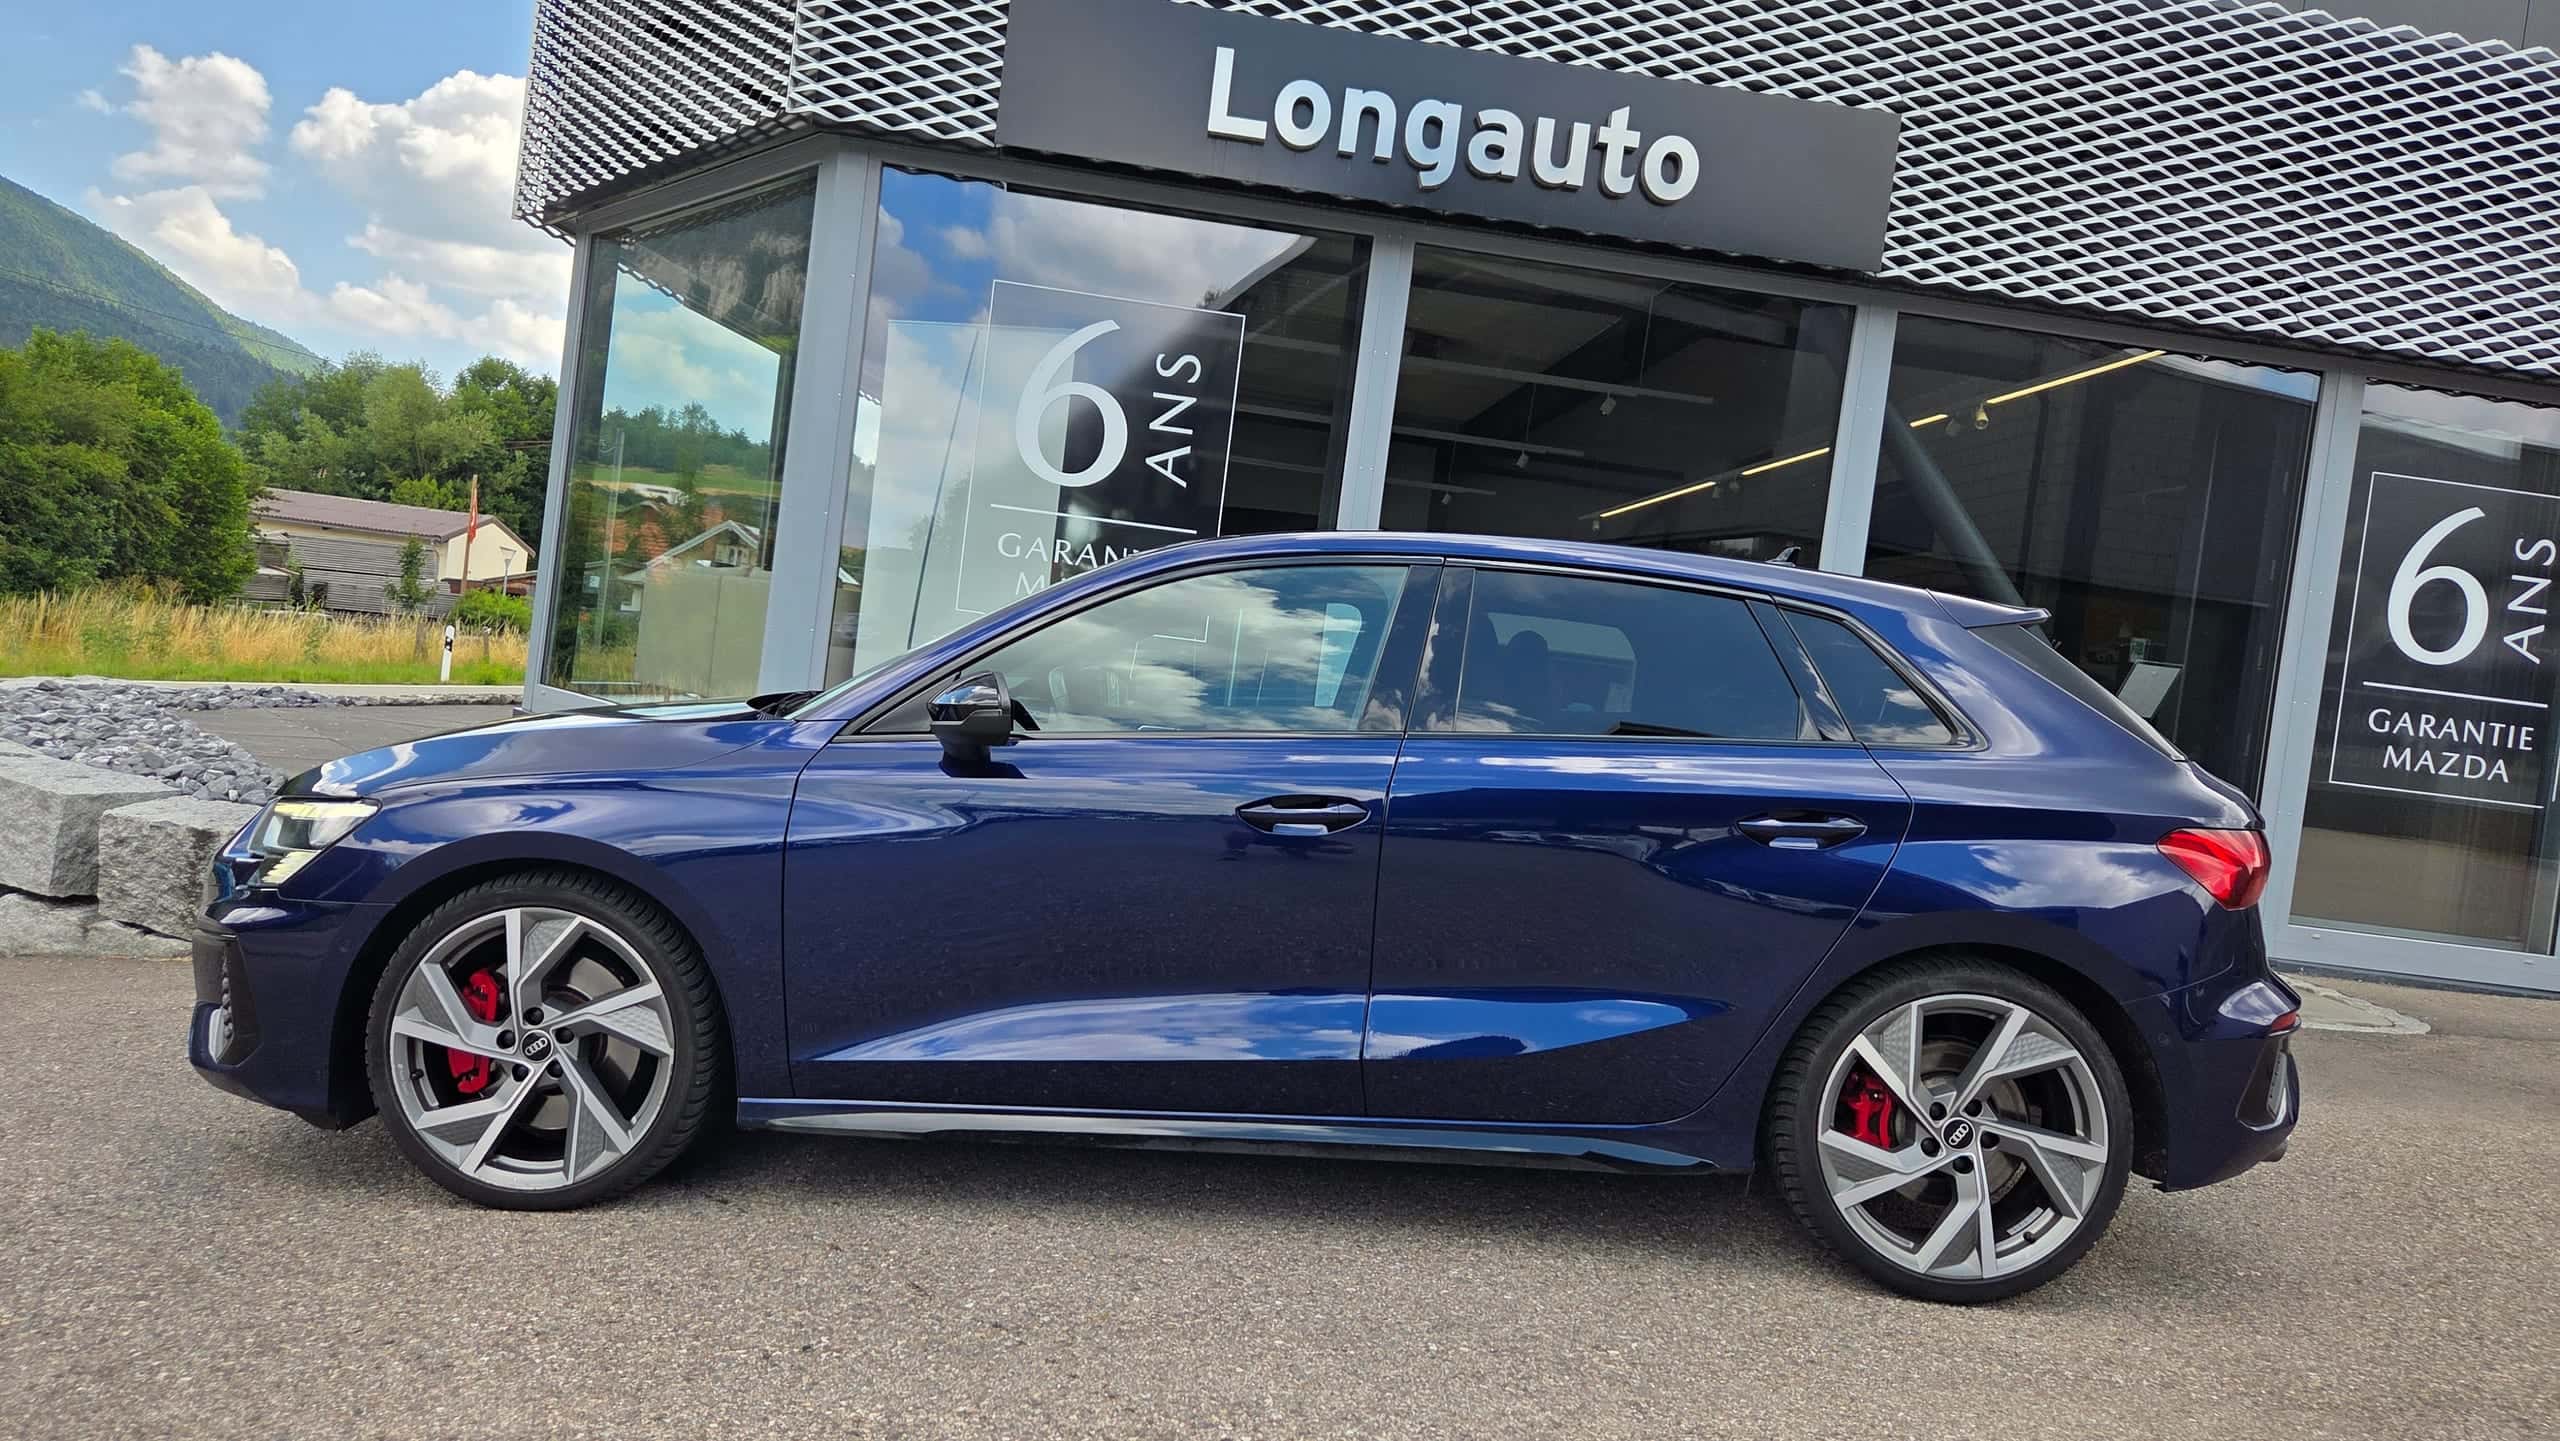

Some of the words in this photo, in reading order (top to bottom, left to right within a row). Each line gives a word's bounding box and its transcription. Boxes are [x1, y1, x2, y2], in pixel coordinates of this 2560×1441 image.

[1207, 46, 1700, 204] Longauto
[1016, 319, 1128, 487] 6
[1145, 353, 1202, 488] ANS
[997, 532, 1141, 569] GARAN
[2387, 506, 2489, 666] 6
[2503, 537, 2557, 665] ANS
[2368, 708, 2535, 751] GARANTIE
[2382, 745, 2509, 783] MAZDA
